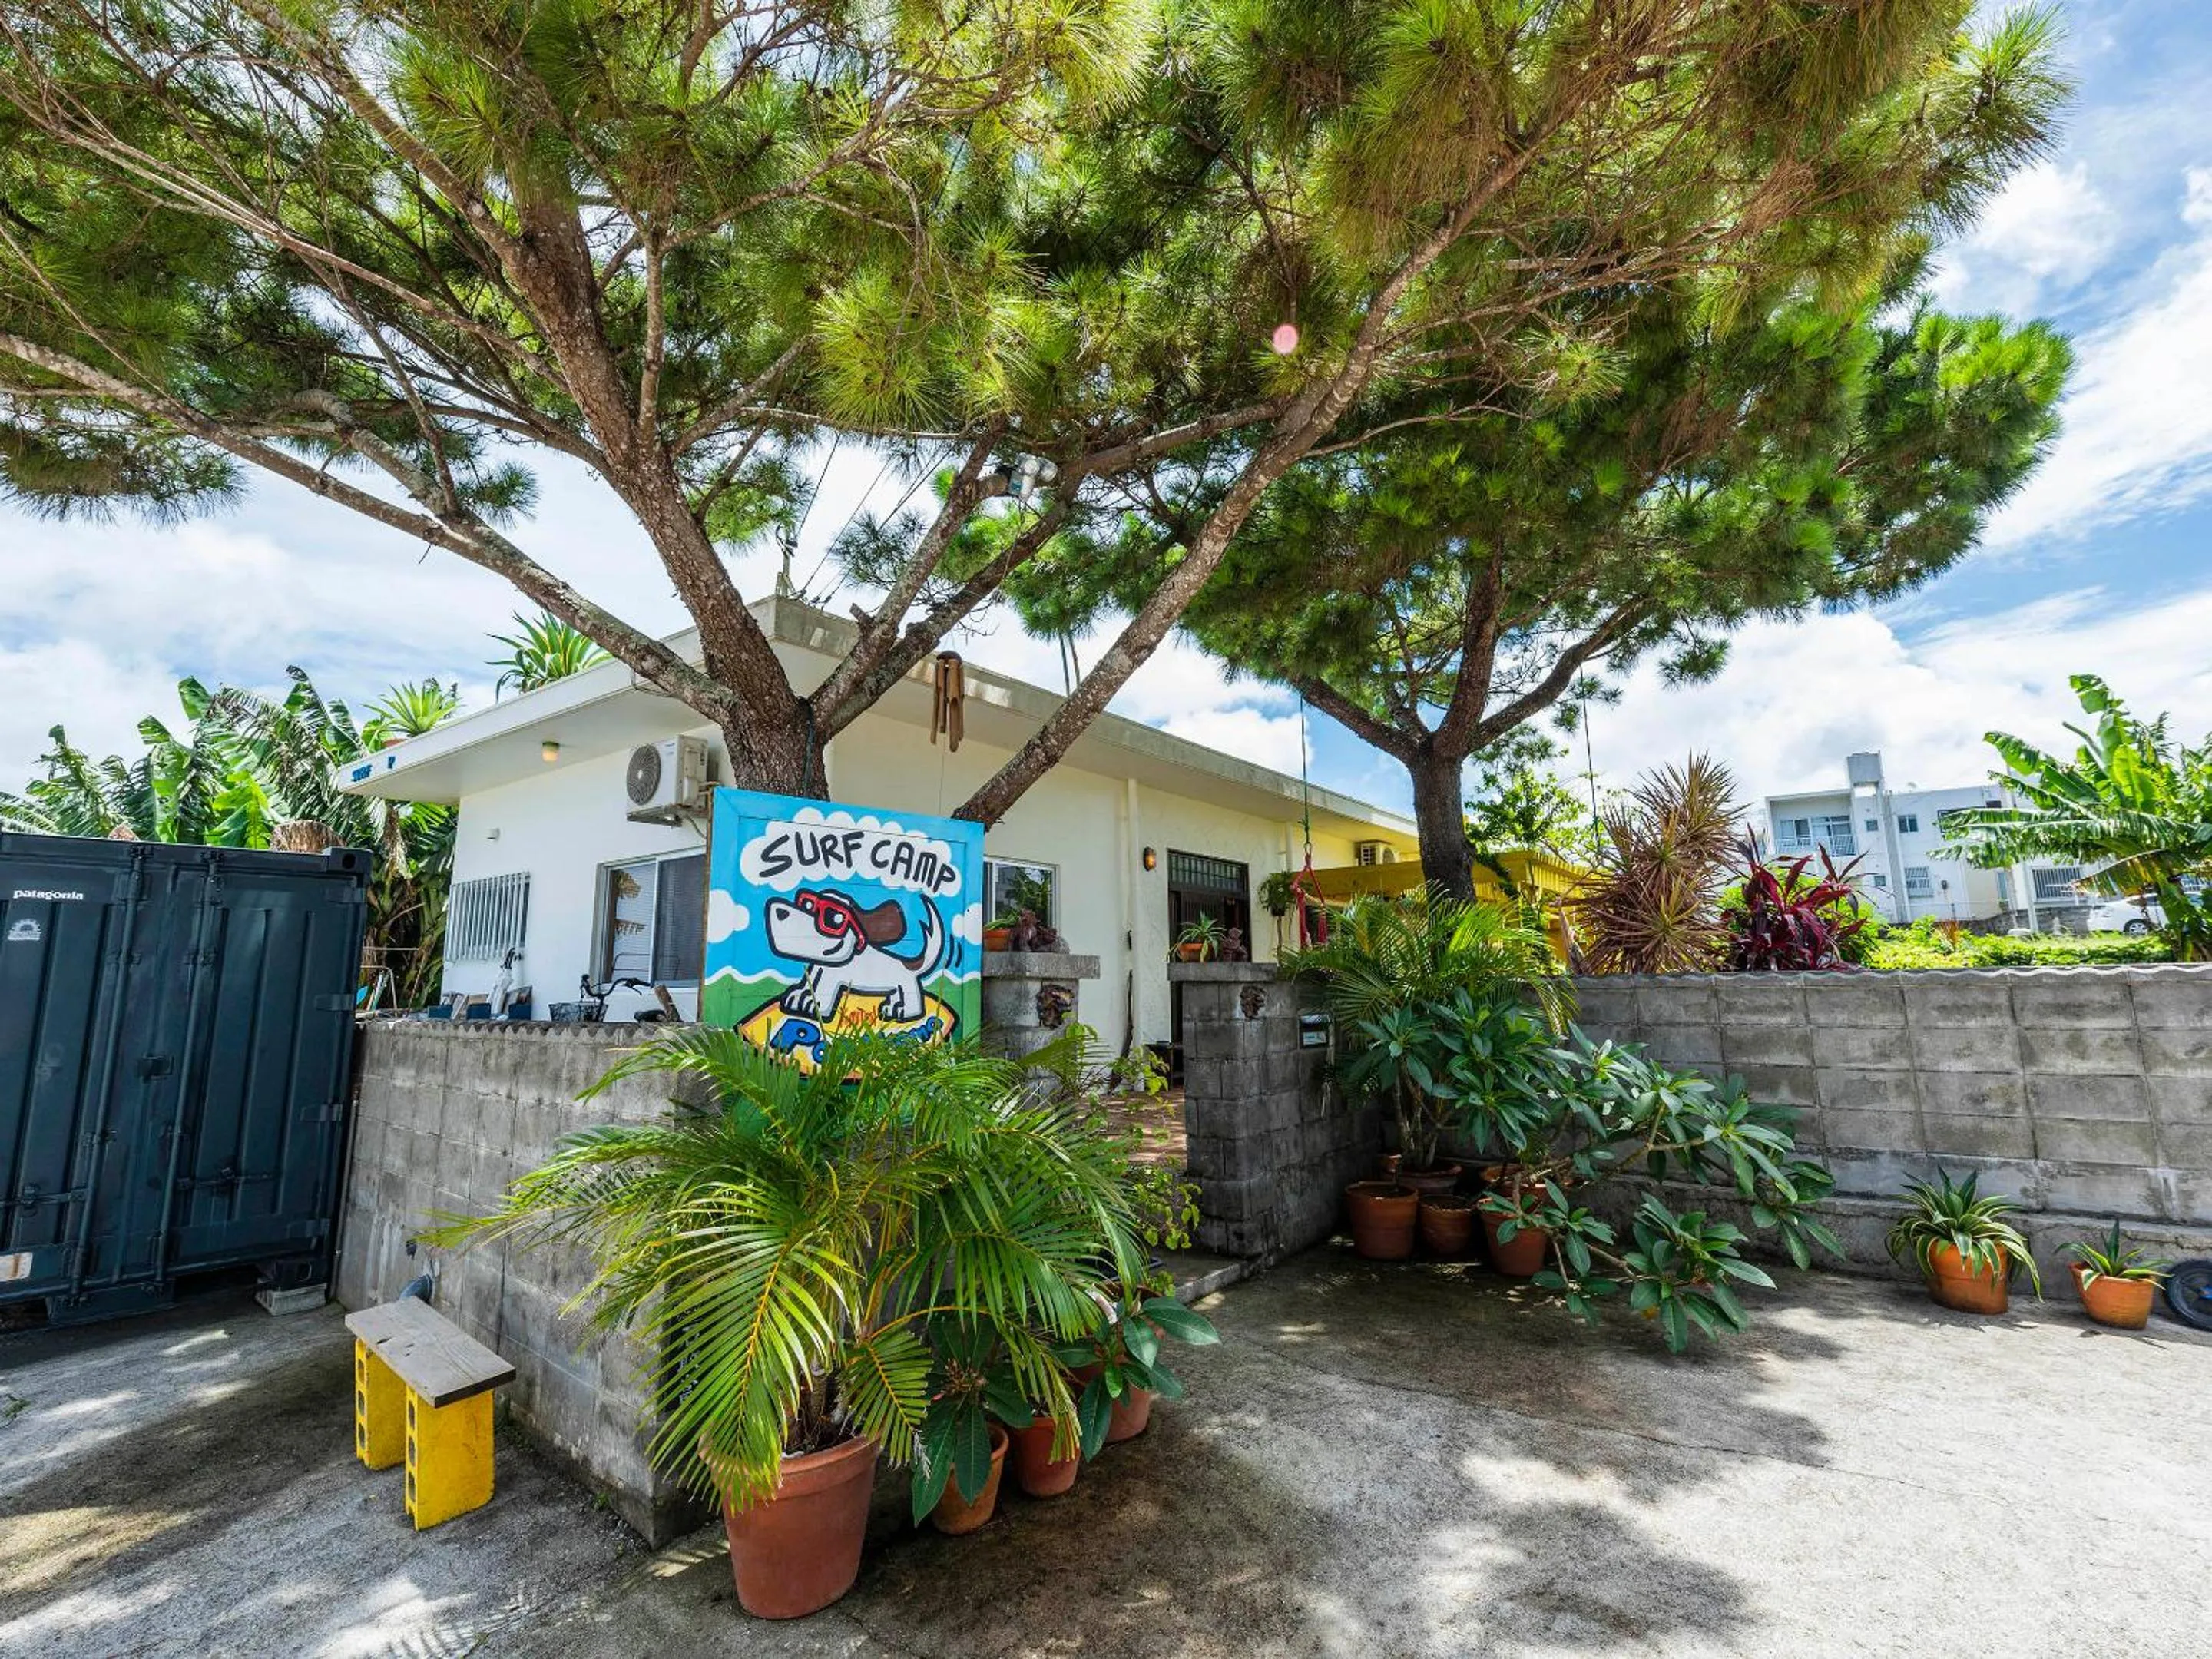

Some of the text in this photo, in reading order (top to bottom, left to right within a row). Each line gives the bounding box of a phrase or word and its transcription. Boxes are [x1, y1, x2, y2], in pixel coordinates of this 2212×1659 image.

[759, 831, 956, 893] SURF CAMP
[13, 890, 84, 900] patagonia
